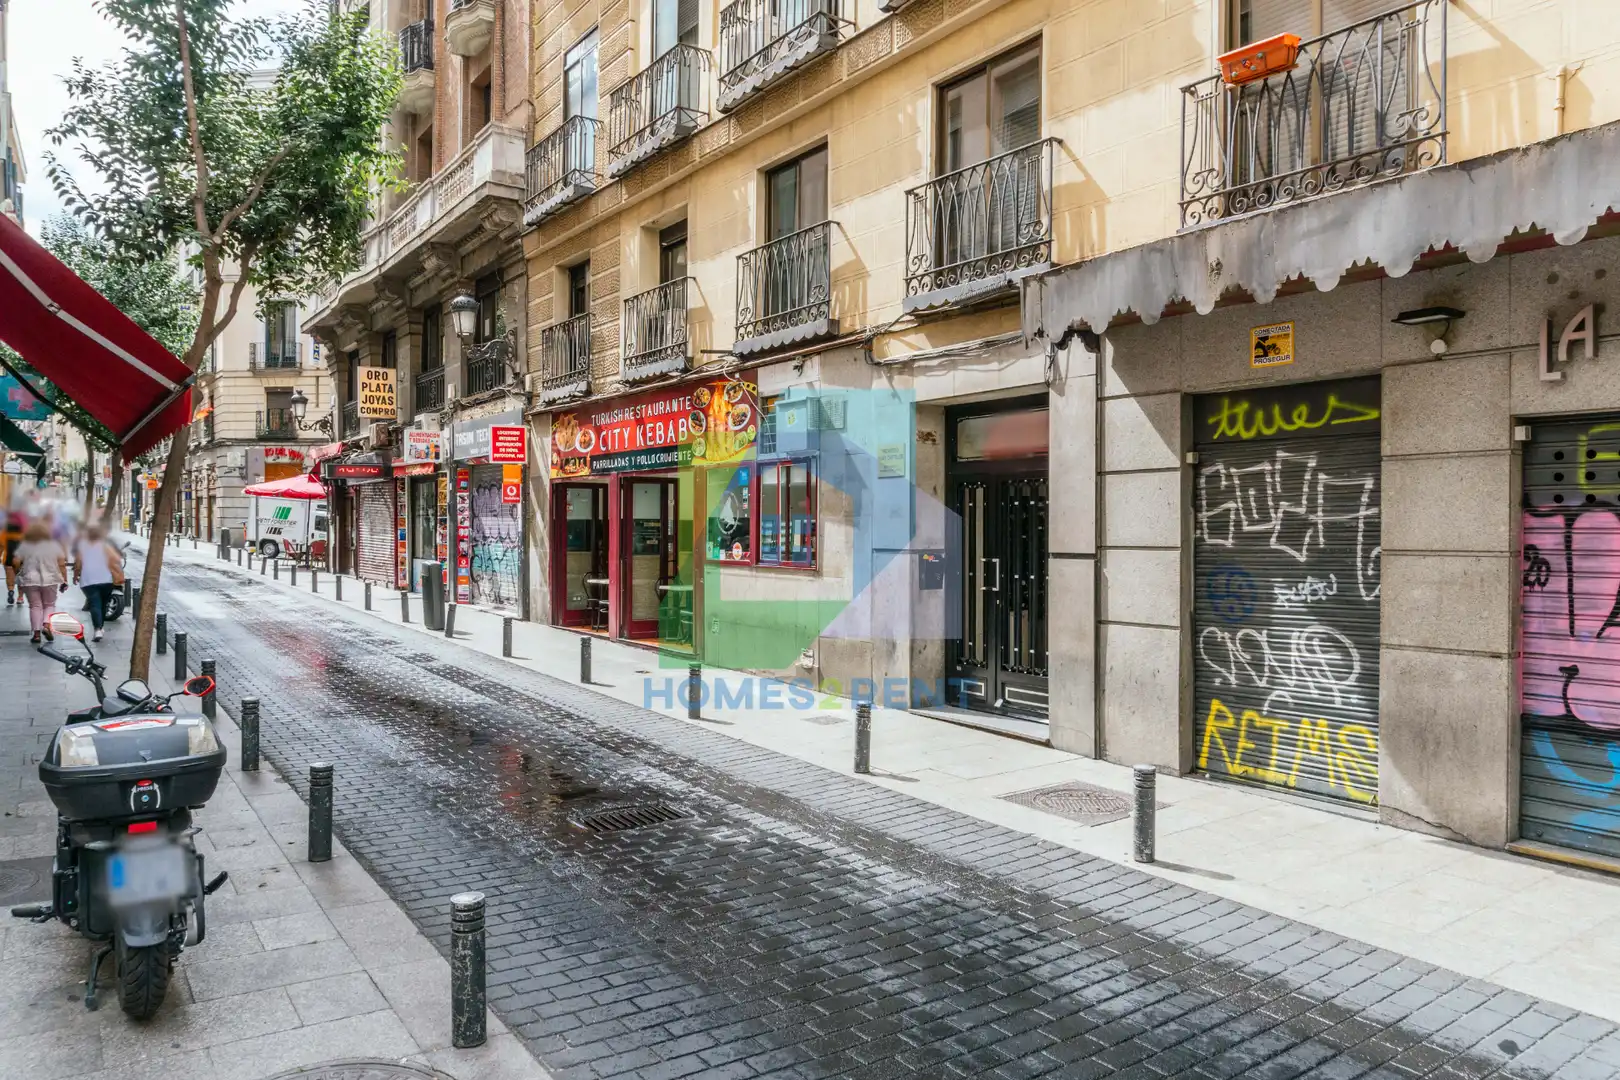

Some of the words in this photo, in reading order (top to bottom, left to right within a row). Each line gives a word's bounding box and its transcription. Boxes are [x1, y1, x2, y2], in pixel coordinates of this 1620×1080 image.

[1253, 324, 1291, 335] CONECTADA
[1539, 302, 1597, 381] LA
[1253, 354, 1291, 365] PROSEGUR
[366, 370, 389, 381] ORO
[361, 381, 394, 394] PLATA
[361, 394, 394, 406] JOYAS
[360, 406, 396, 416] COMPRO
[591, 409, 622, 427] TURKISH
[624, 396, 692, 421] RESTAURANTE
[599, 425, 631, 452] CITY
[636, 417, 688, 448] KEBAB
[592, 456, 629, 470] PARRILLADAS
[631, 456, 636, 465] Y
[636, 454, 656, 465] POLLO
[655, 450, 692, 463] CRUJIENTE
